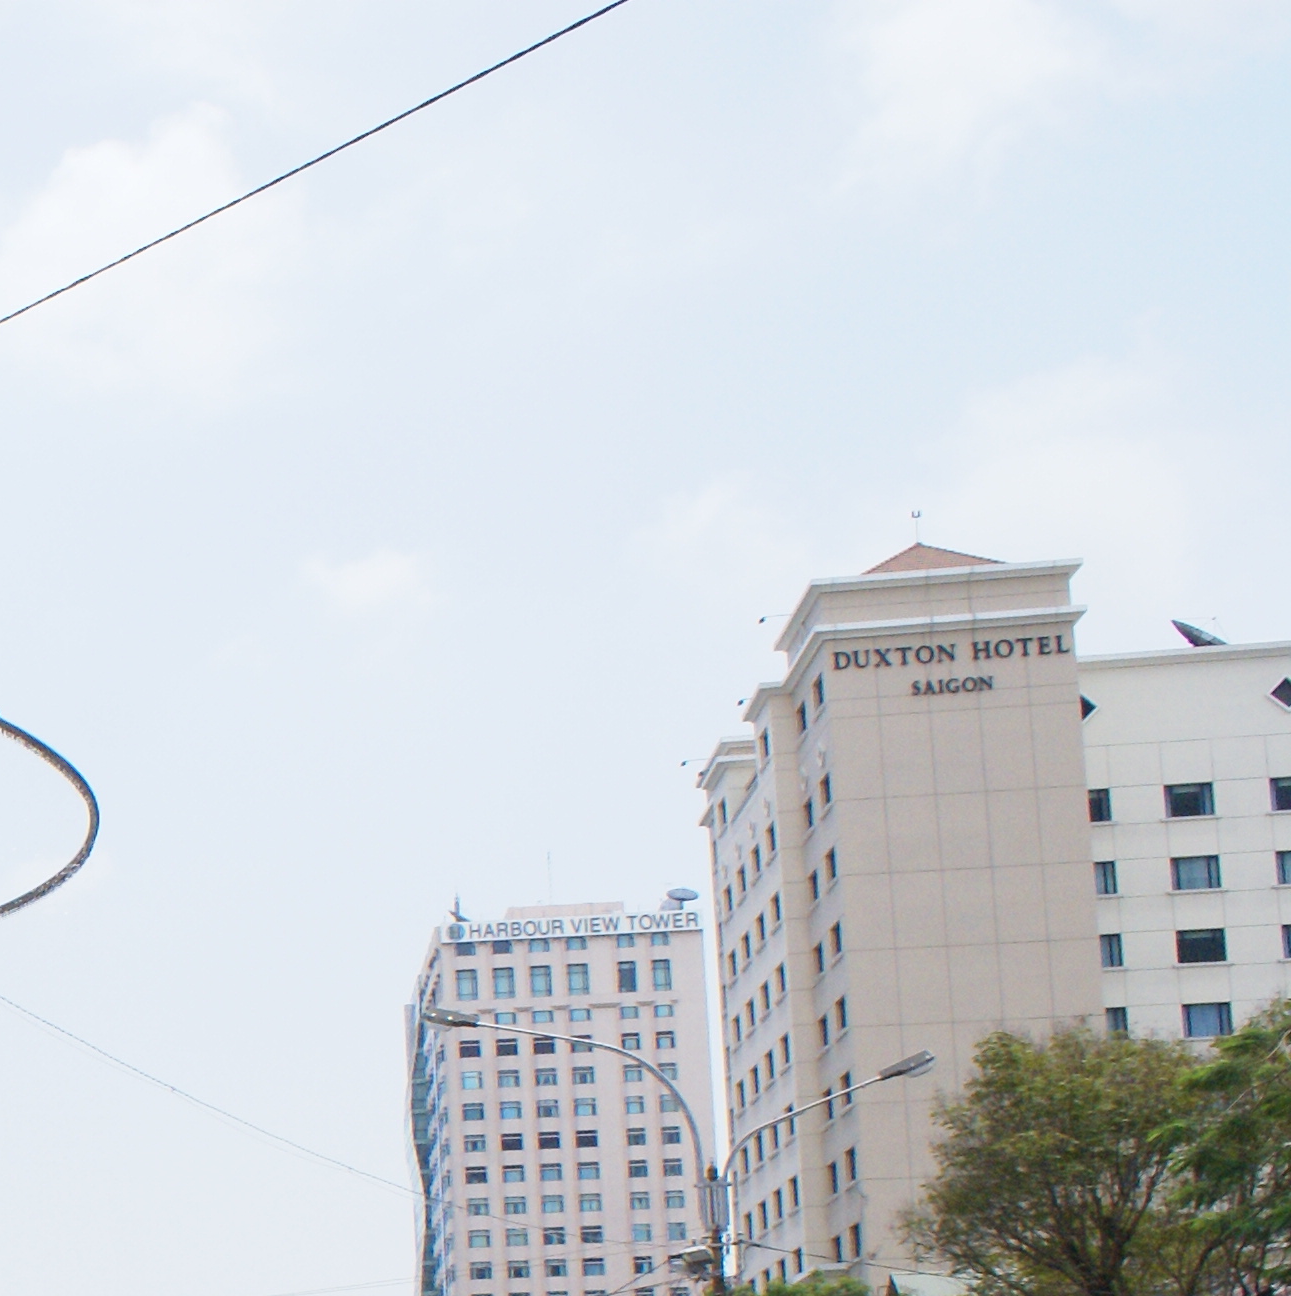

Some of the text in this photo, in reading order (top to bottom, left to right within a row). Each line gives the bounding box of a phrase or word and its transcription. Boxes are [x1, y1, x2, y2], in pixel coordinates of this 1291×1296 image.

[832, 634, 1070, 671] DUXTON HOTEL
[911, 675, 995, 696] SAIGON
[469, 911, 700, 939] HARBOUR VIEW TOWER
